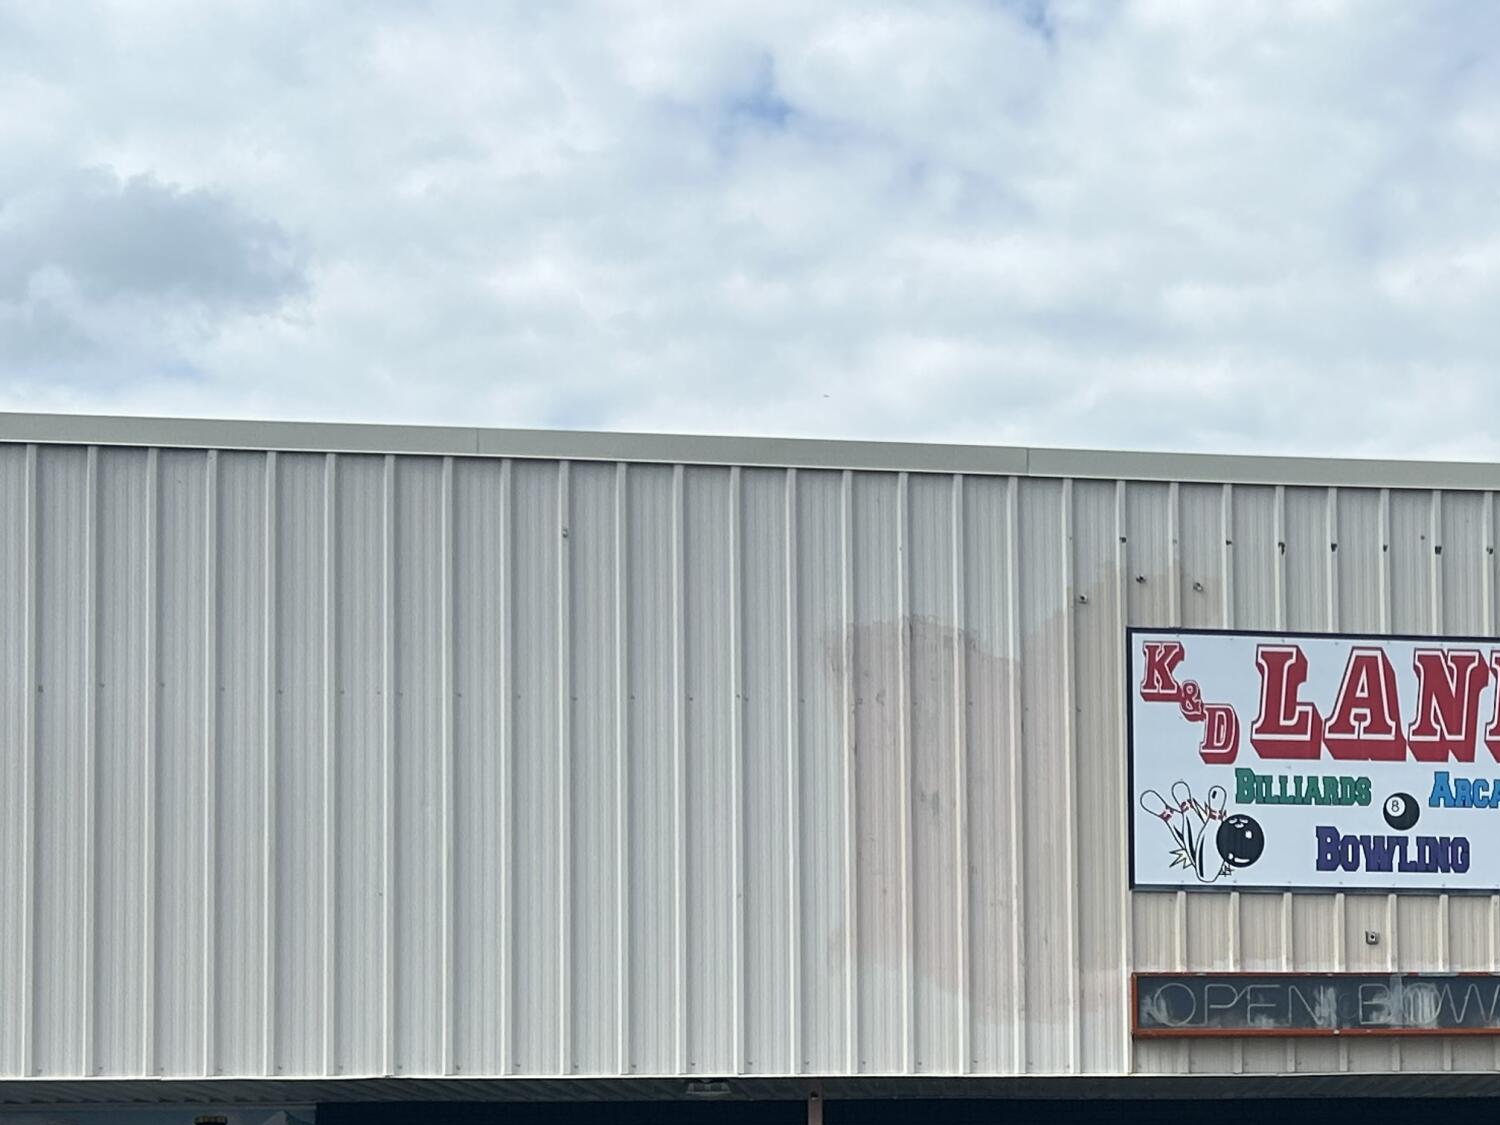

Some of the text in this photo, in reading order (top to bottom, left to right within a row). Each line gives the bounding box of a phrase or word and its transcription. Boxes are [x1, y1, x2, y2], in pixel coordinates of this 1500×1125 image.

[1235, 768, 1371, 806] BILLIARDS
[1315, 826, 1470, 874] BOWLING
[1153, 983, 1325, 1027] OPEN
